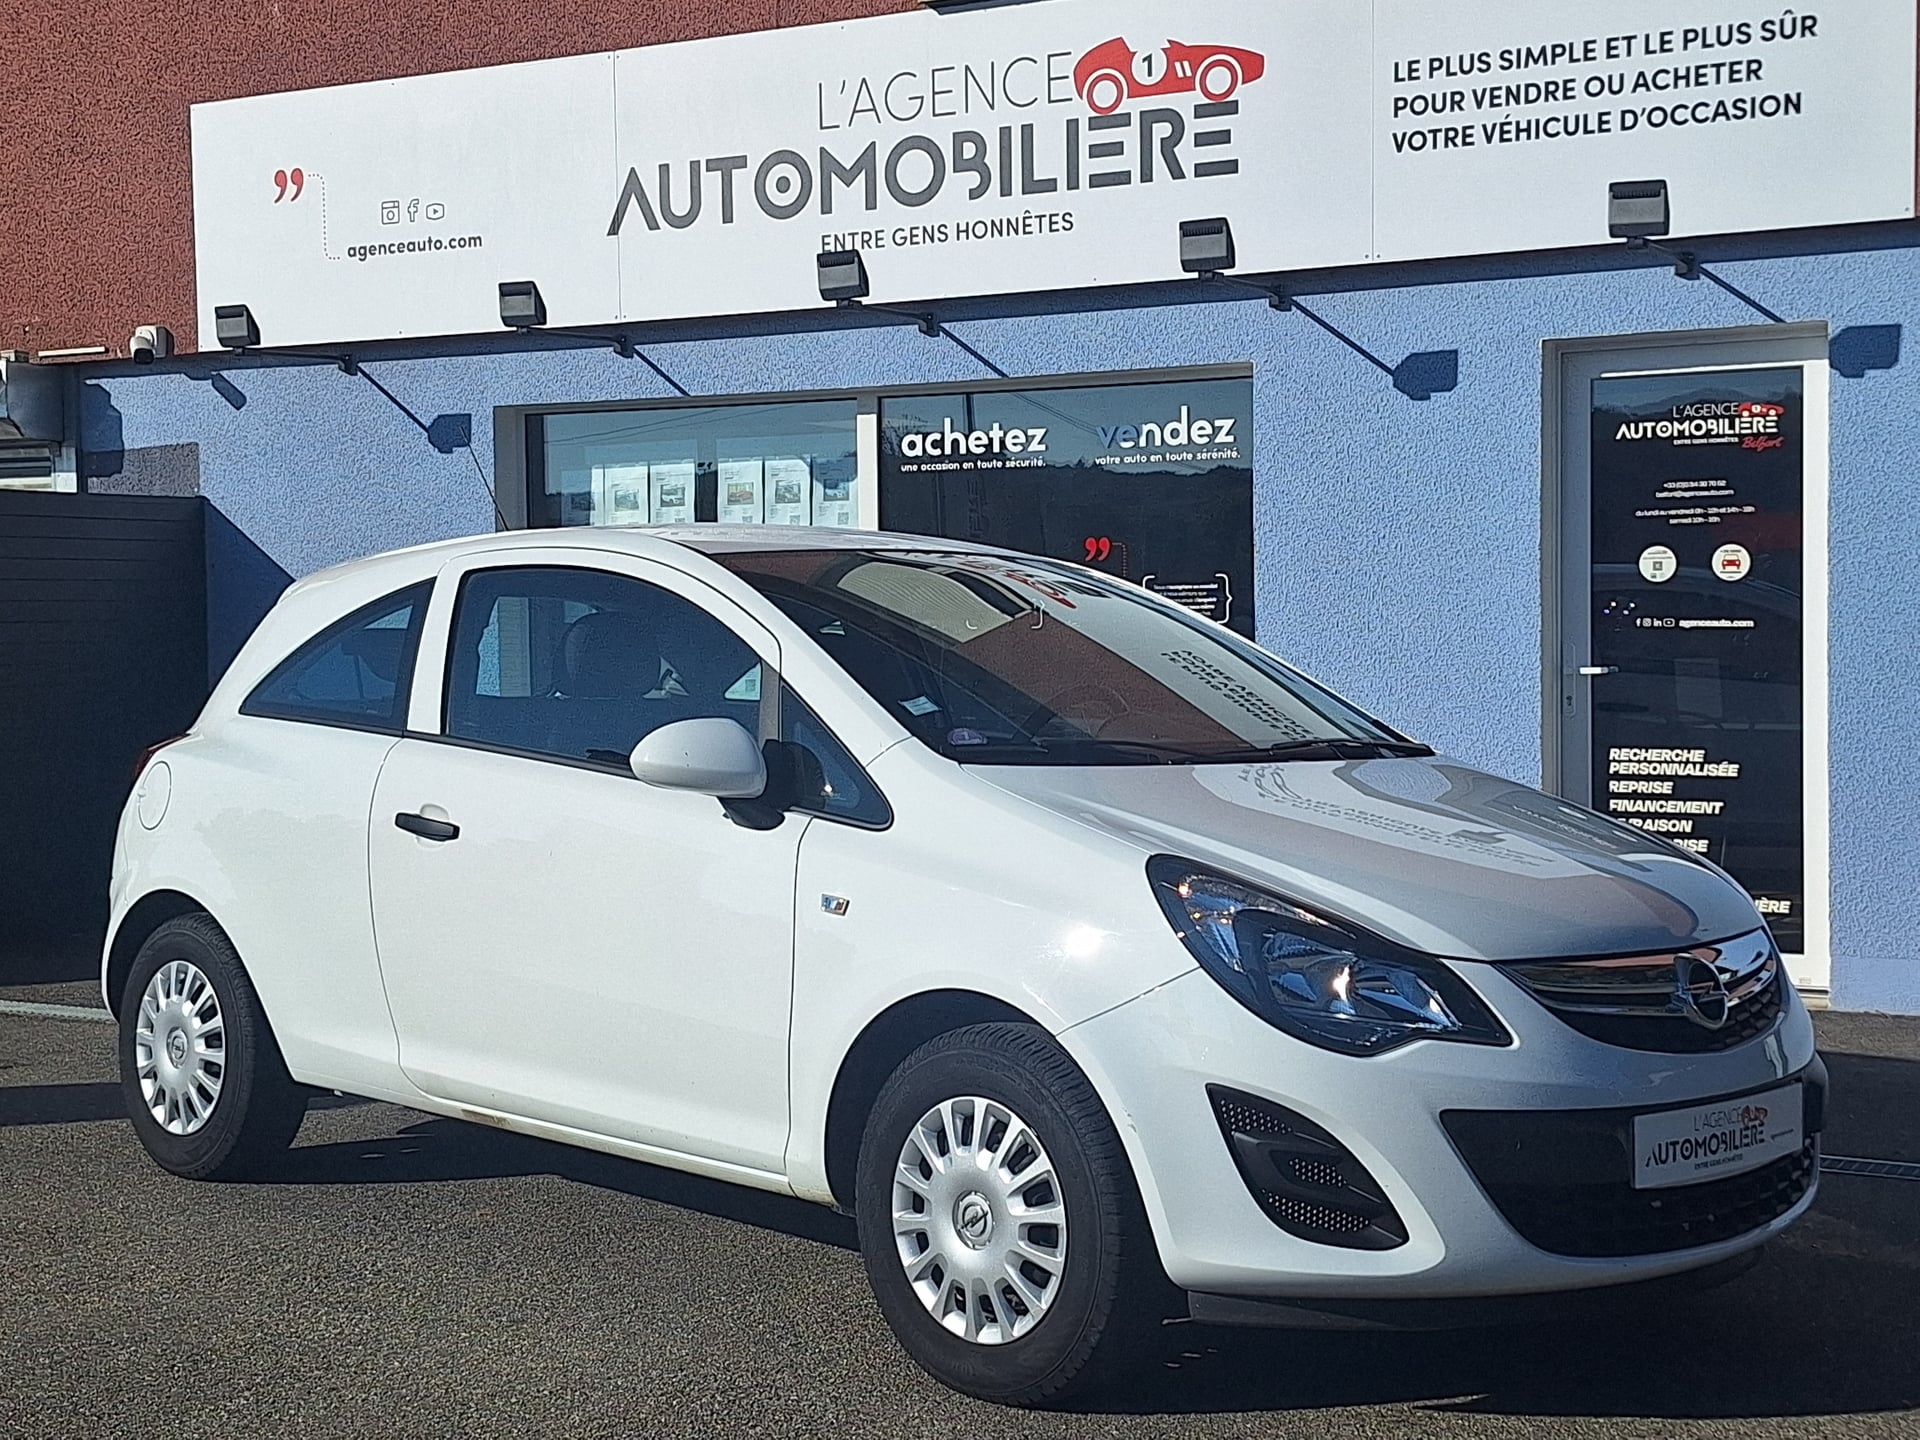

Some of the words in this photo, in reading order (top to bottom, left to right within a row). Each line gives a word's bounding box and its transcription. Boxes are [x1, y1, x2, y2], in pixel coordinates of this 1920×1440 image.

[1393, 60, 1420, 83] LE
[1429, 51, 1492, 80] PLUS
[1498, 38, 1597, 71] SIMPLE
[1605, 34, 1638, 59] ET
[1644, 30, 1674, 55] LE
[1682, 22, 1752, 51] PLUS
[1760, 10, 1818, 42] SÛR
[818, 51, 1073, 131] L'AGENCE
[1393, 90, 1465, 118] POUR
[1472, 78, 1577, 110] VENDRE
[1584, 72, 1625, 97] OU
[1631, 58, 1763, 94] ACHETER
[1392, 124, 1475, 154] VOTRE
[1482, 110, 1612, 145] VÉHICULE
[1620, 92, 1802, 131] D'OCCASION
[821, 229, 885, 253] ENTRE
[892, 224, 948, 246] GENS
[956, 210, 1074, 241] HONNÊTES
[347, 235, 482, 261] agenceauto.com
[1673, 402, 1739, 418] L'AGENCE
[901, 417, 1047, 457] achetez
[1096, 405, 1236, 449] vendez
[901, 464, 918, 472] une
[921, 461, 960, 471] occasion
[963, 461, 974, 469] en
[977, 459, 1002, 469] toute
[1095, 455, 1120, 465] votre
[1124, 454, 1147, 463] auto
[1150, 454, 1162, 462] en
[1166, 451, 1193, 461] toute
[1609, 748, 1705, 762] RECHERCHE
[1609, 761, 1739, 777] PERSONNALISÉE
[1609, 780, 1674, 794] REPRISE
[1609, 799, 1724, 814] FINANCEMENT
